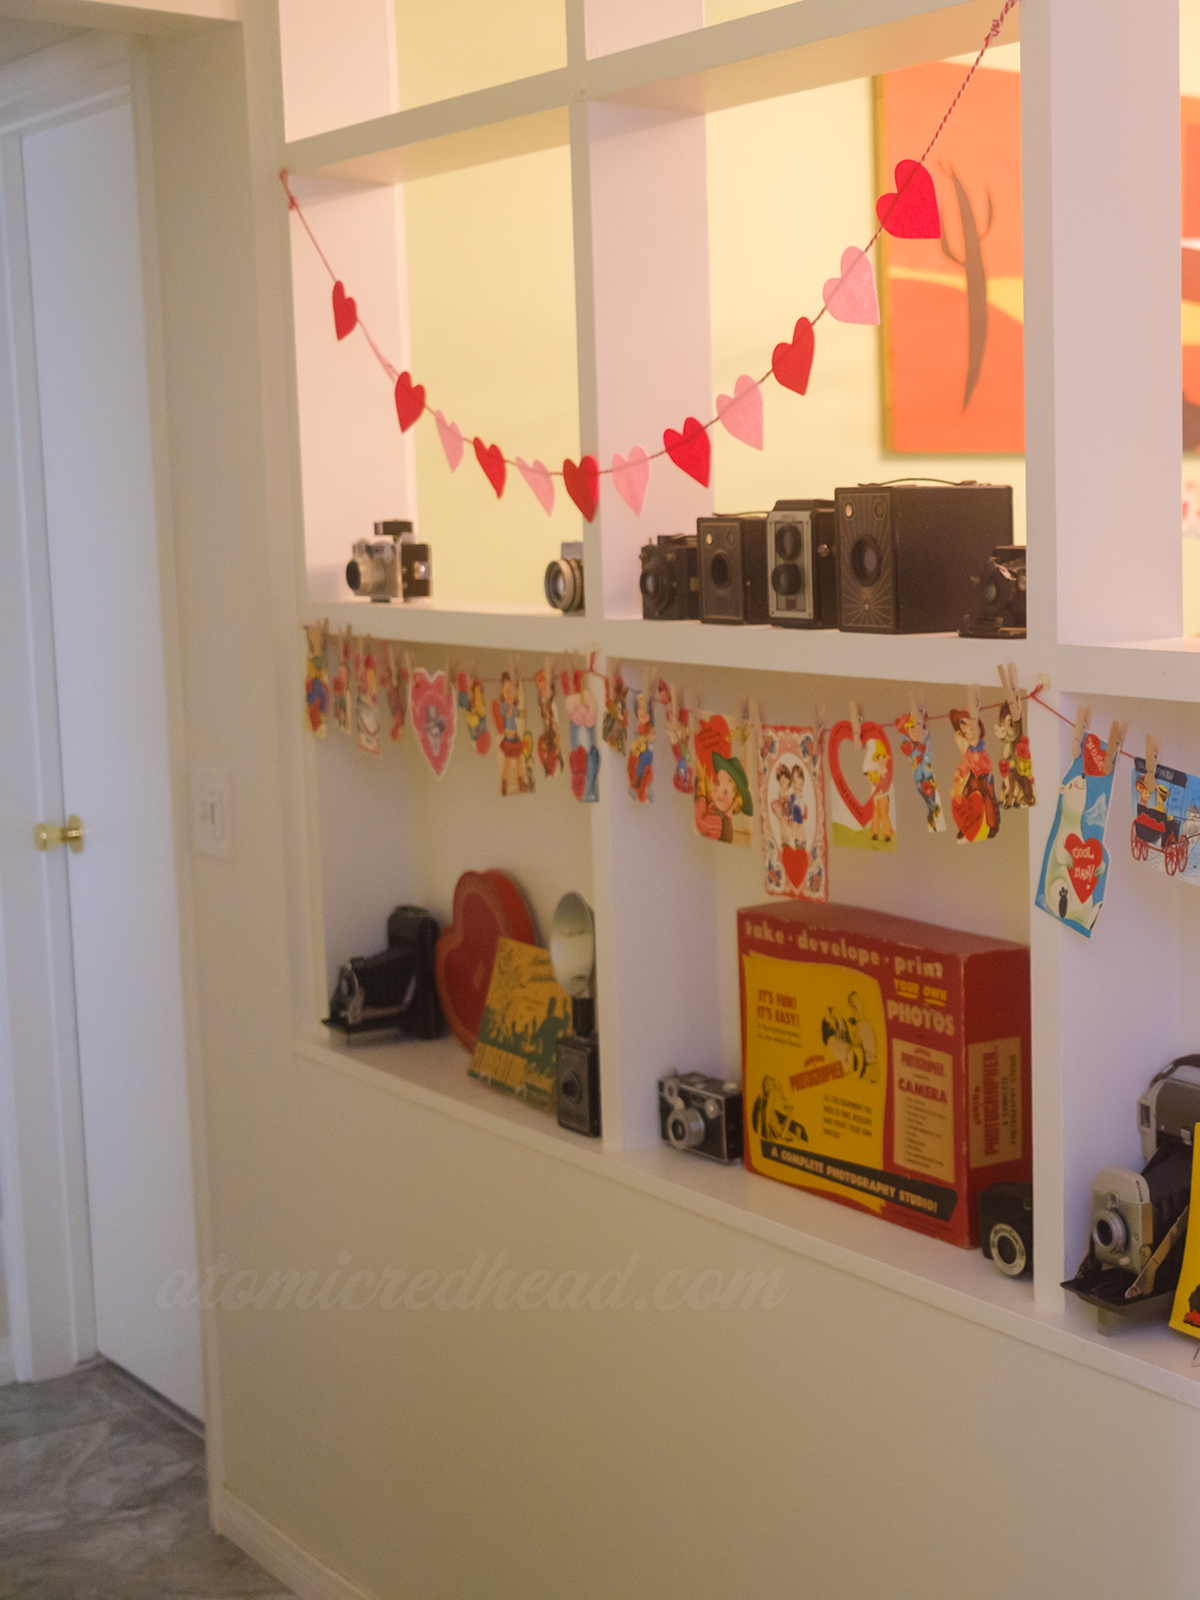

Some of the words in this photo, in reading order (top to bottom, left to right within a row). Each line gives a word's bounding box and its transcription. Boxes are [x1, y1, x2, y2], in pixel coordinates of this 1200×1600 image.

[1072, 846, 1095, 860] COOL
[745, 921, 785, 944] take
[797, 930, 880, 966] develope
[894, 955, 944, 979] print
[758, 988, 774, 1004] IT'S
[776, 993, 797, 1010] FUN!
[894, 979, 920, 995] YOUR
[923, 986, 947, 1001] OWN
[756, 1004, 773, 1021] IT'S
[775, 1009, 801, 1028] EASY!
[887, 999, 955, 1036] PHOTOS
[898, 1077, 948, 1105] CAMERA
[770, 1146, 778, 1158] A
[781, 1151, 824, 1173] COMPLETE
[826, 1165, 897, 1198] PHOTOGRAPHY
[898, 1189, 938, 1213] STUDIO!
